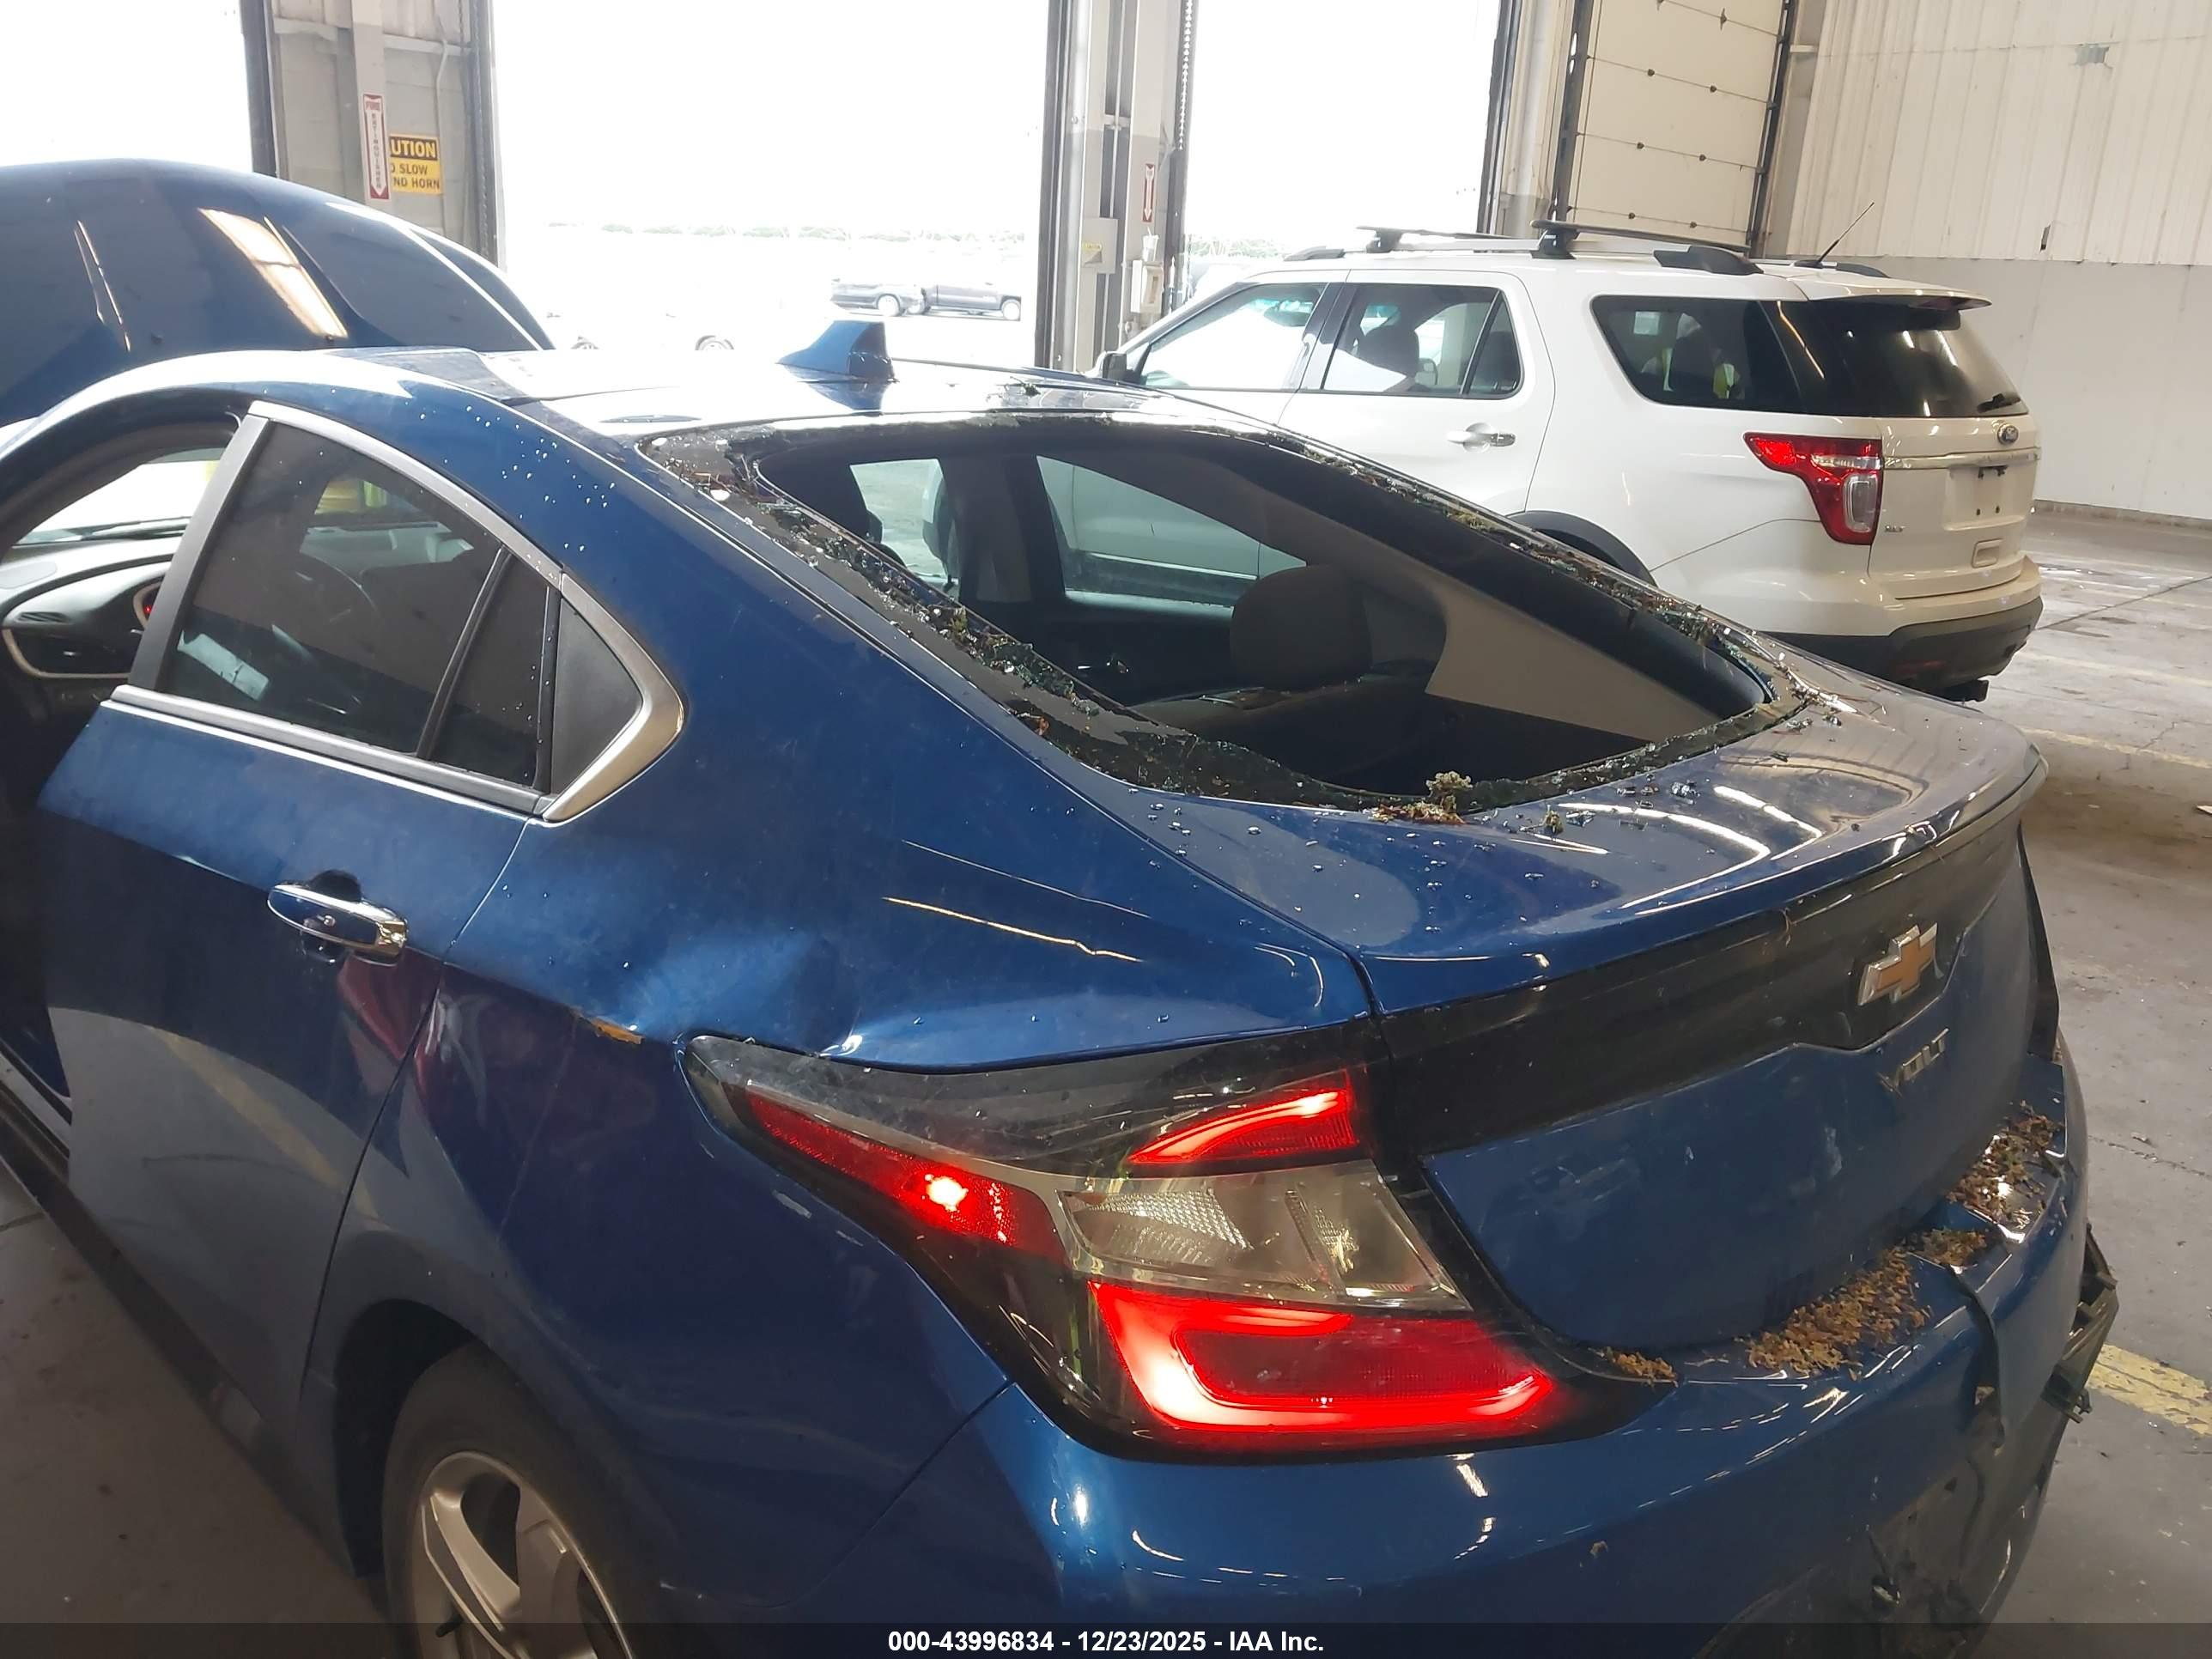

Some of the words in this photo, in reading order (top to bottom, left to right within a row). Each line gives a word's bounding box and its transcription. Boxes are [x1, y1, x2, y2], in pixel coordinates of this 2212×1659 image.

[391, 139, 436, 158] UTION
[399, 162, 428, 175] SLOW
[412, 178, 440, 189] HORN
